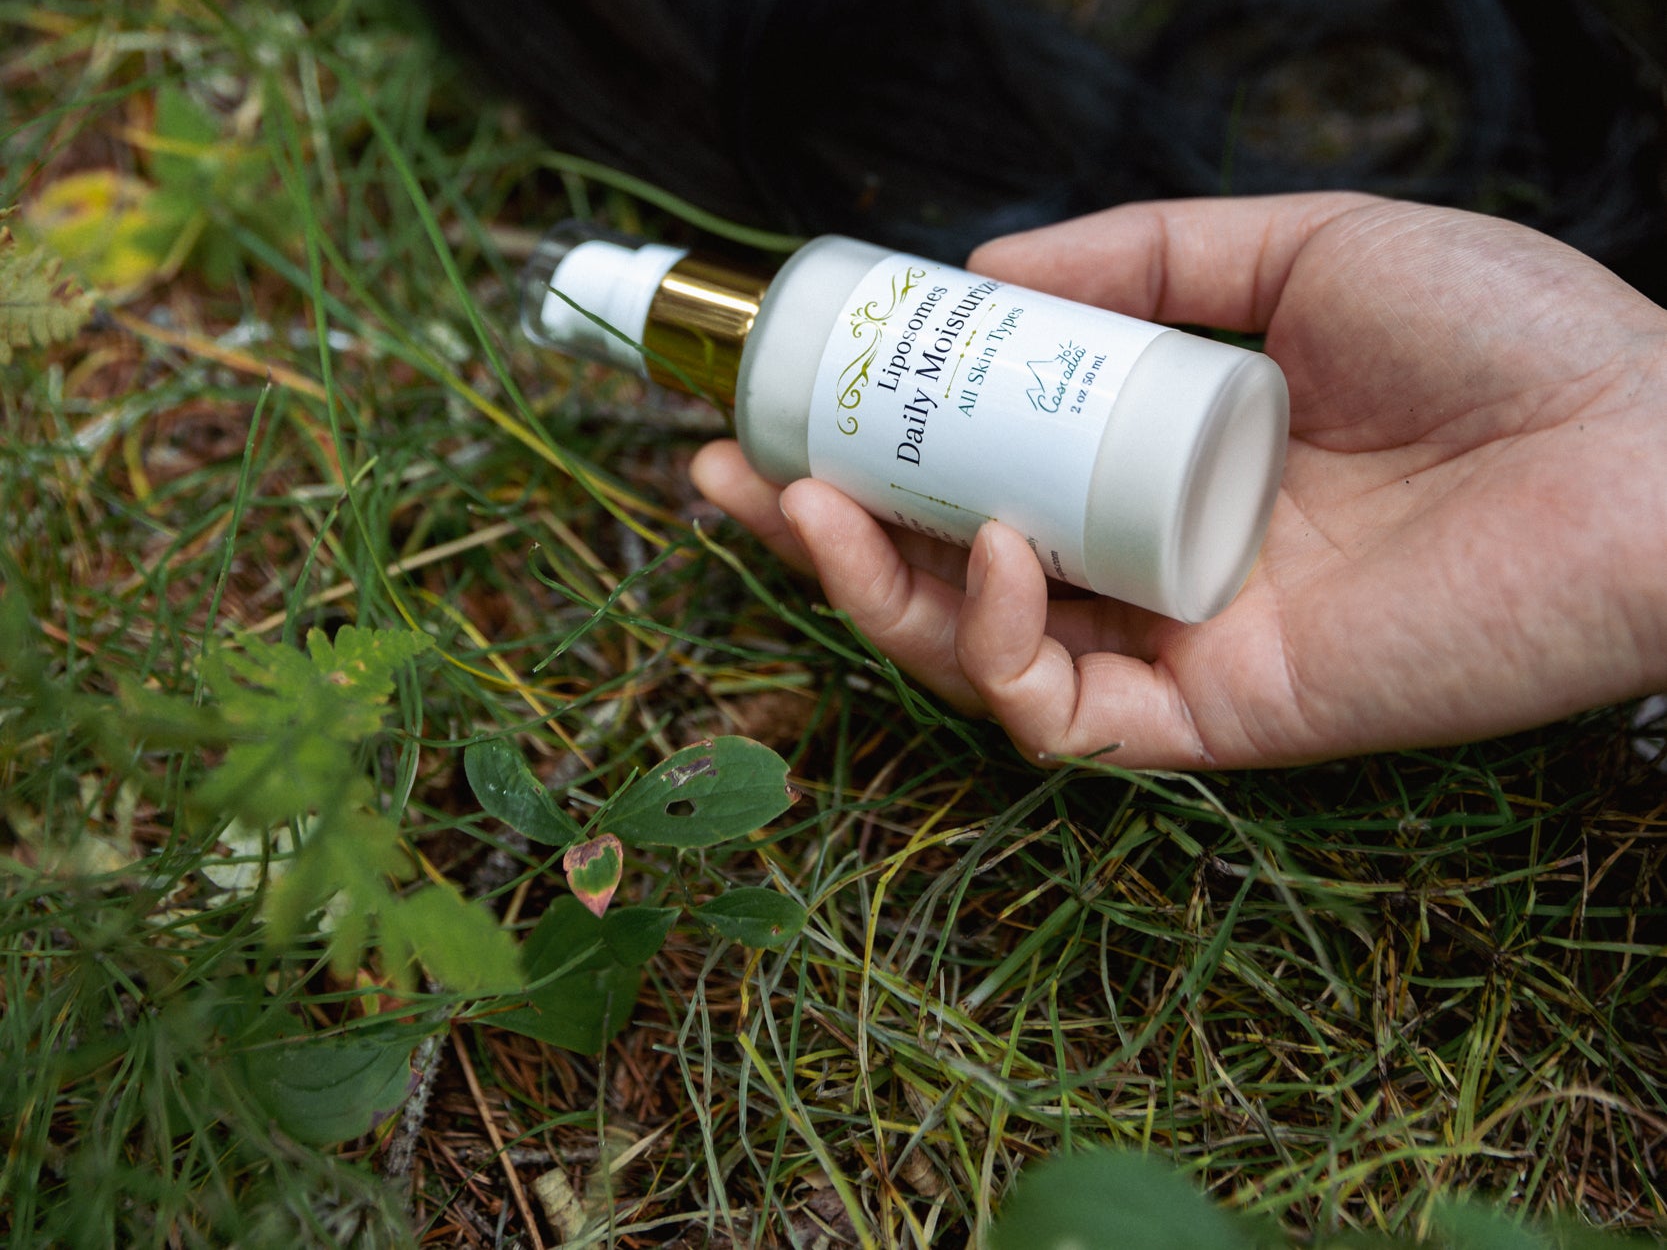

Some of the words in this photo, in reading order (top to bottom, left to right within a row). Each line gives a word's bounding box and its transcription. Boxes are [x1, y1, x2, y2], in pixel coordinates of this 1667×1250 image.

[877, 285, 948, 392] Liposomes
[915, 281, 1003, 382] Moisturize
[987, 306, 1024, 347] Types
[967, 348, 997, 386] Skin
[1037, 348, 1087, 413] Cascadia
[1070, 405, 1082, 414] 2
[1082, 371, 1096, 386] 50
[1091, 354, 1107, 370] mL
[896, 388, 938, 466] Daily
[958, 390, 979, 418] All
